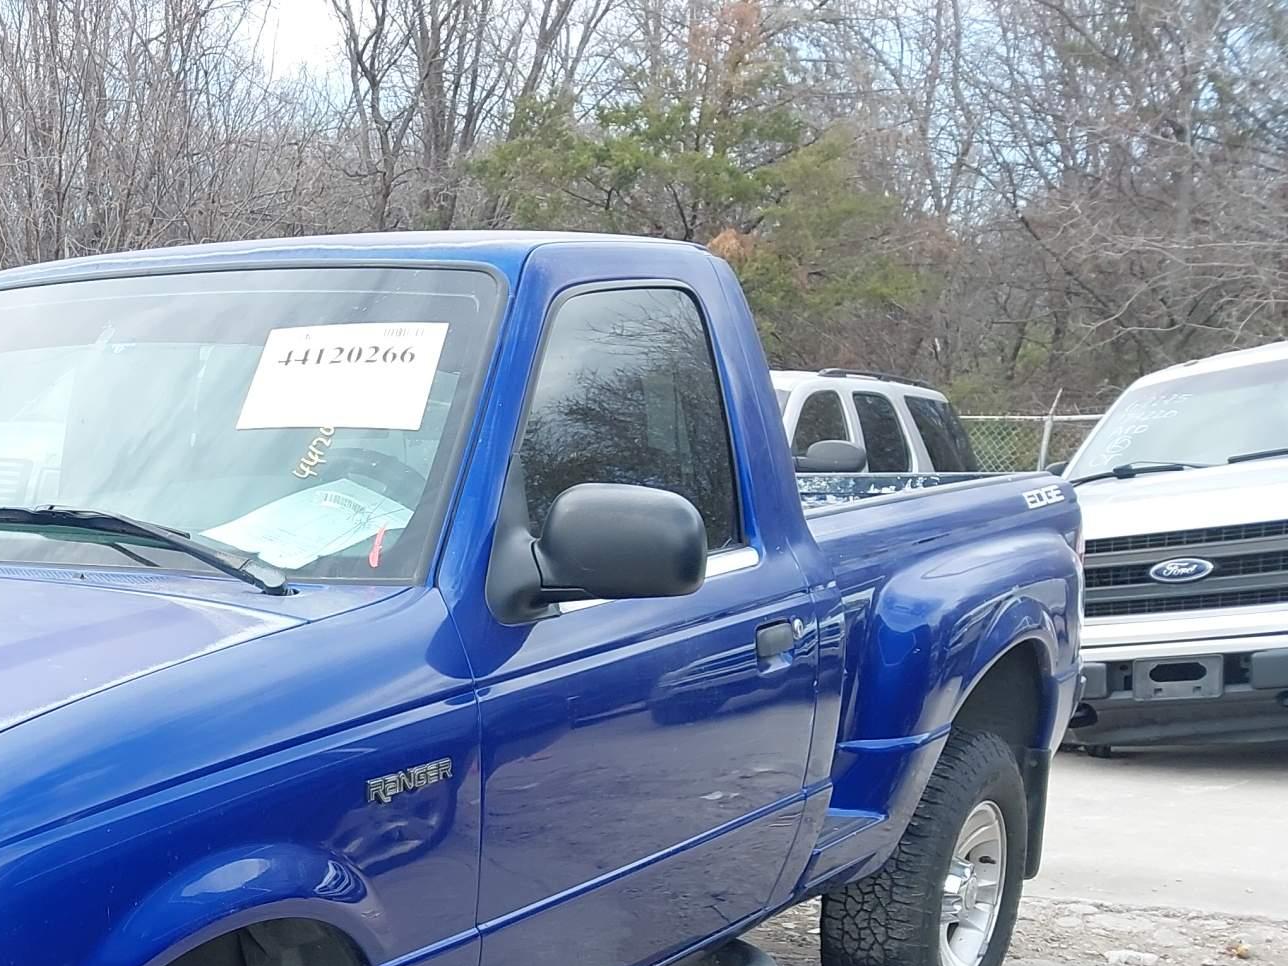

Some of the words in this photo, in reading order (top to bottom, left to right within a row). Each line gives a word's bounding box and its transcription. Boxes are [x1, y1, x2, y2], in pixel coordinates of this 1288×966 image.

[277, 345, 417, 367] 44120266
[1022, 484, 1065, 509] EDGE
[1161, 561, 1198, 576] Ford
[367, 757, 453, 803] RANGER
